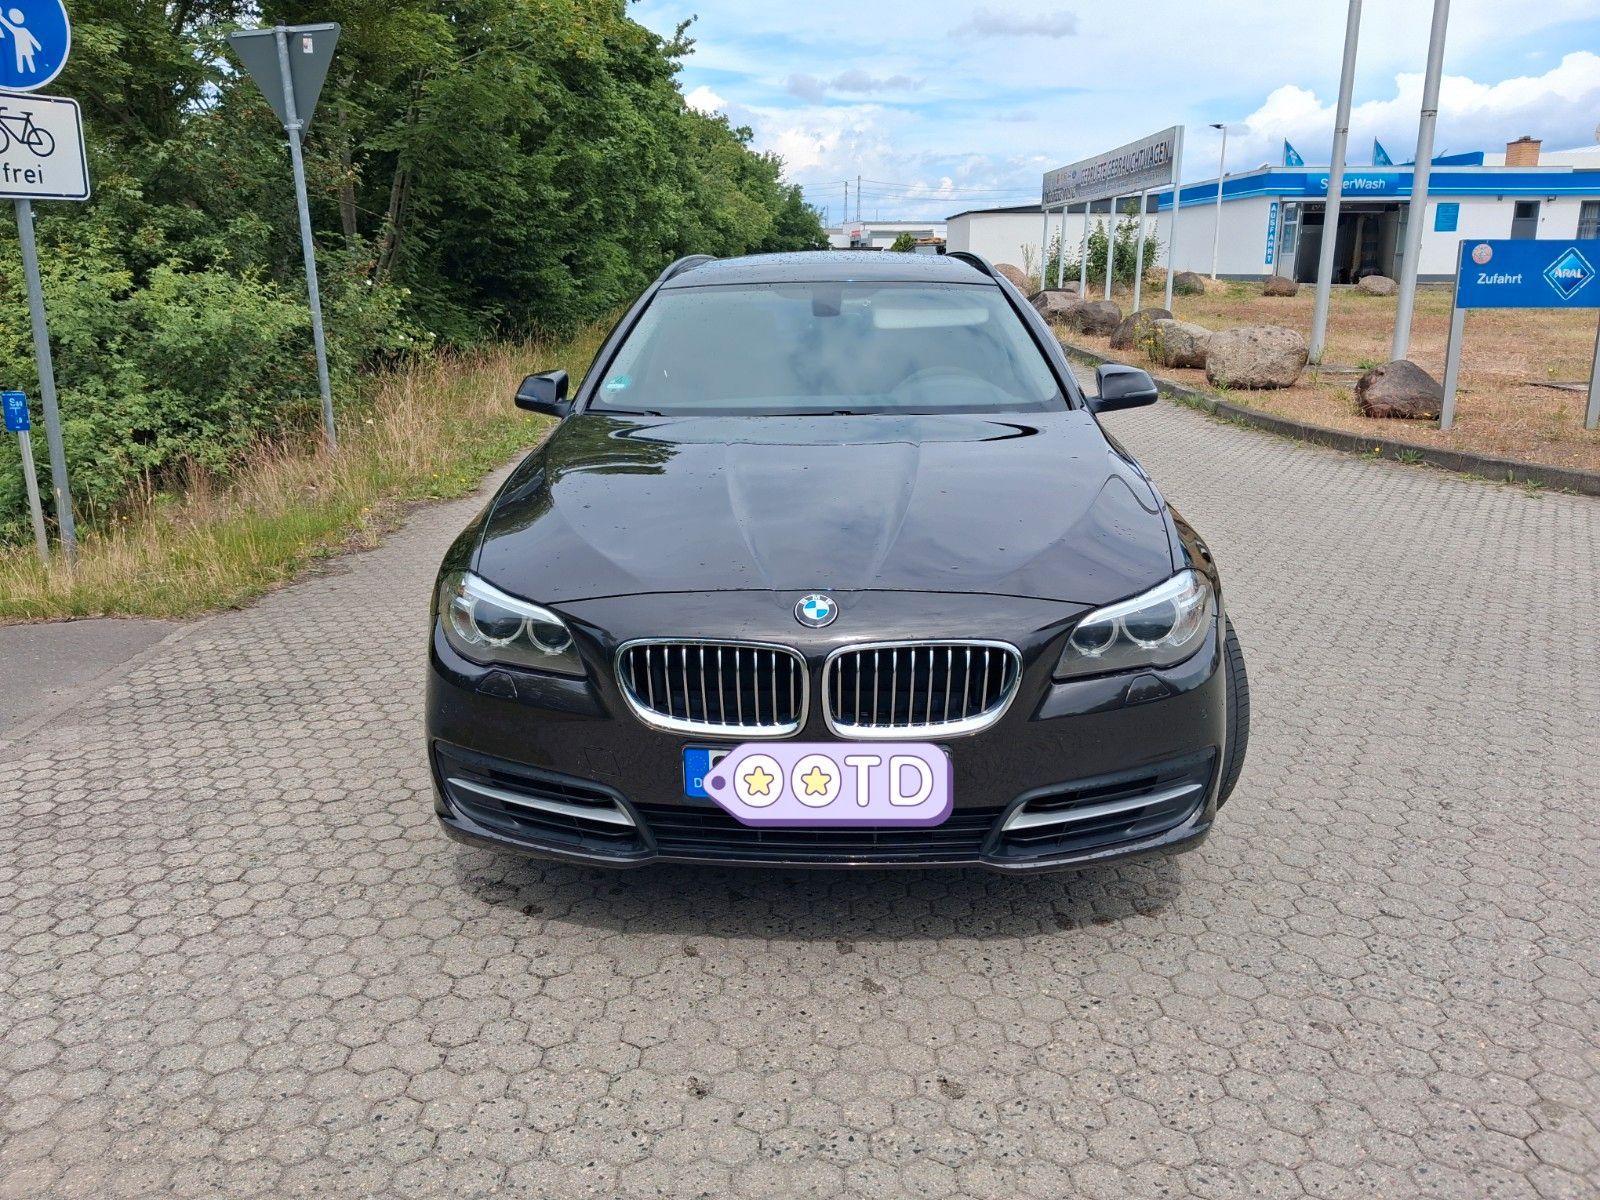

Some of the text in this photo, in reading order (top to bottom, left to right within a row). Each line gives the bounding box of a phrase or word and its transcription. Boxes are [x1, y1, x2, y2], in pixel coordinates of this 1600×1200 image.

[3, 162, 43, 184] frei
[1320, 178, 1386, 190] SerWash
[1477, 273, 1522, 284] Zufahrt
[1554, 269, 1583, 279] ARAL
